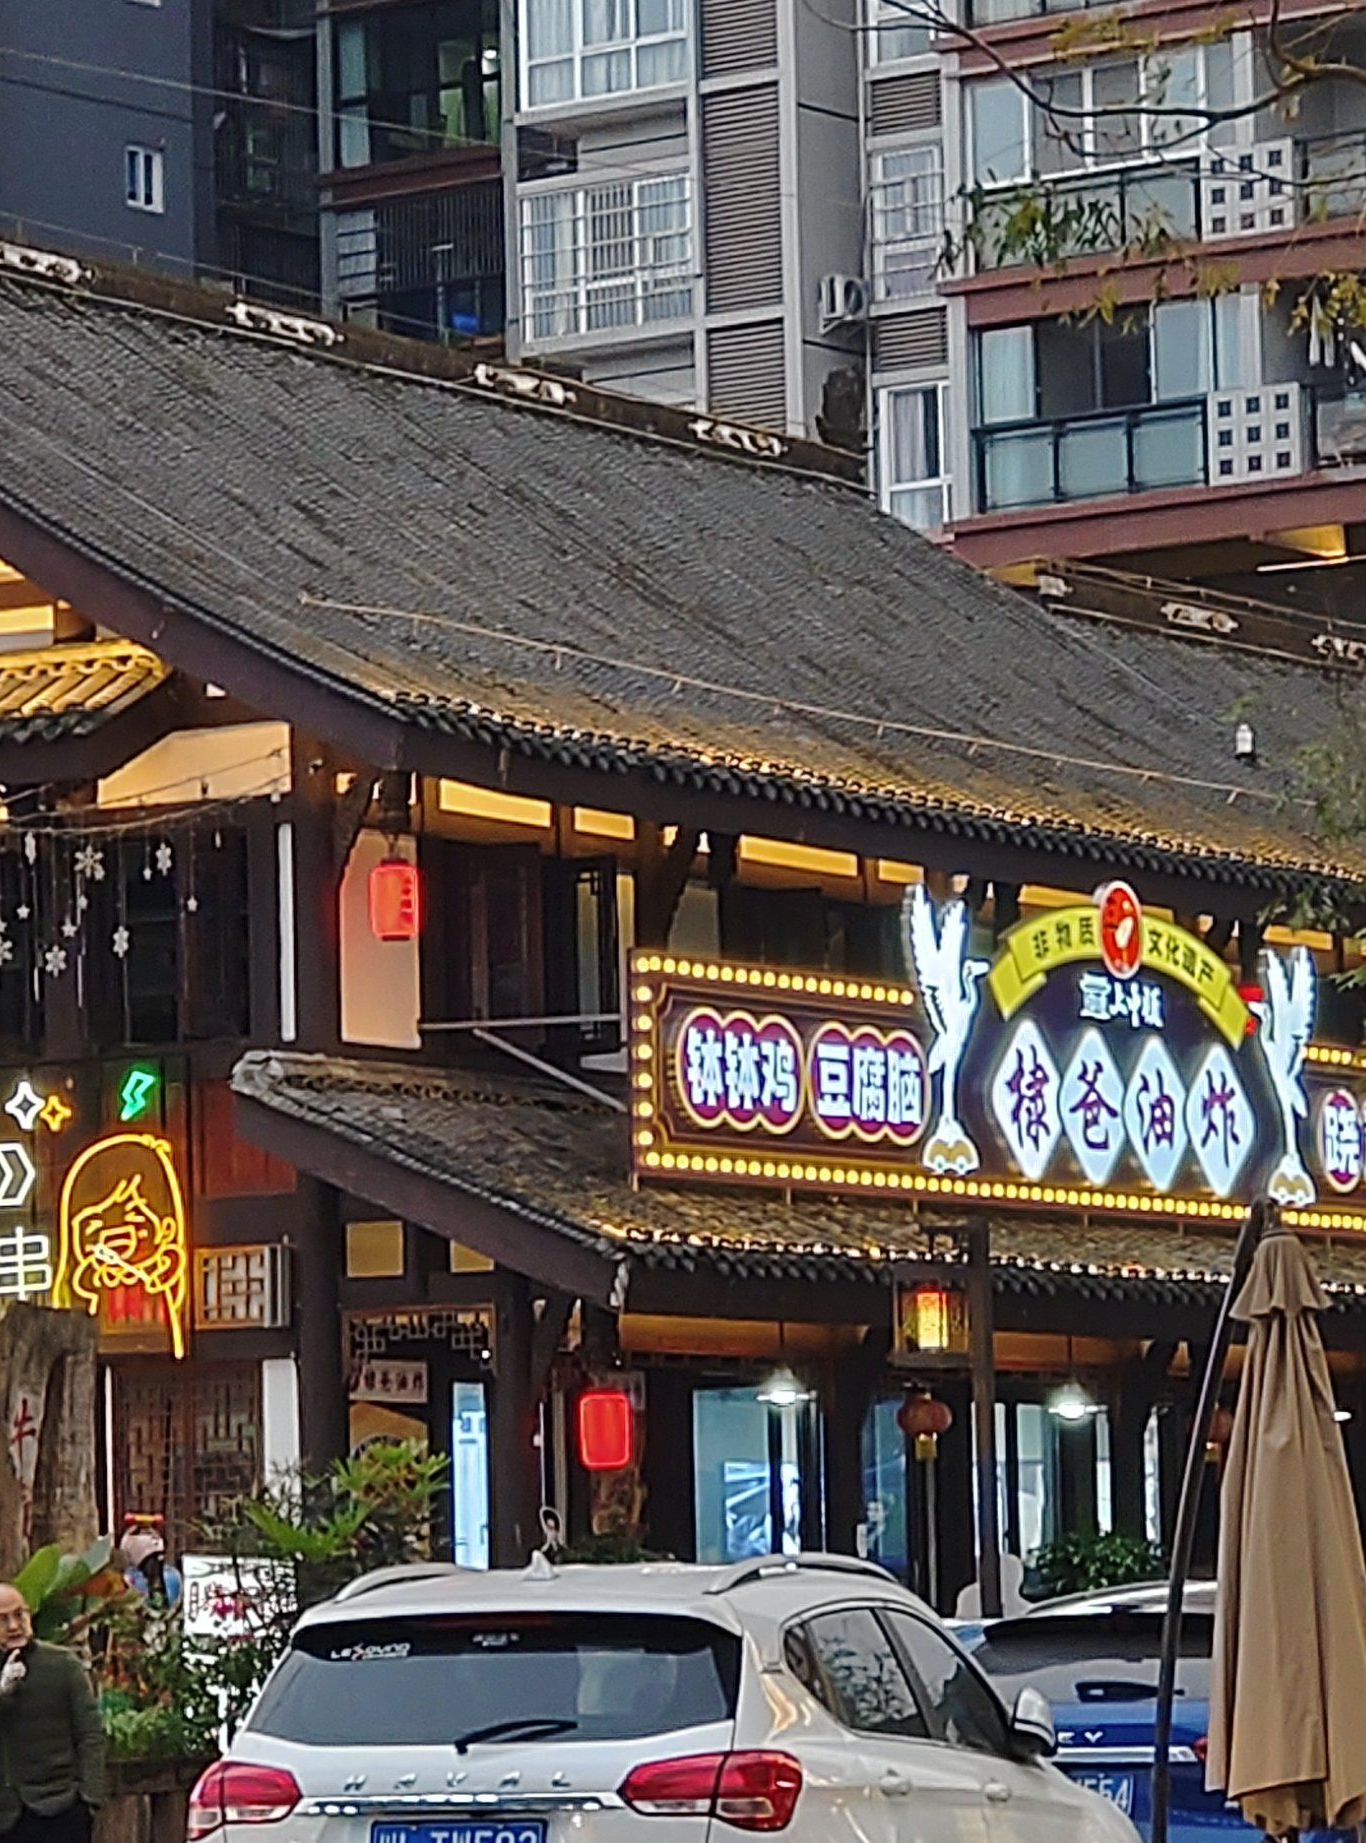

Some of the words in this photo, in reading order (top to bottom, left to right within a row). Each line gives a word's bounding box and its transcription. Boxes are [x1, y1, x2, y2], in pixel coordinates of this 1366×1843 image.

[1032, 916, 1096, 960] 非物质
[1147, 927, 1215, 984] 文化遗产
[686, 1025, 797, 1113] 钵钵鸡
[816, 1042, 922, 1126] 豆腐脑
[1057, 1731, 1104, 1744] EY
[343, 1769, 562, 1793] HAVAL
